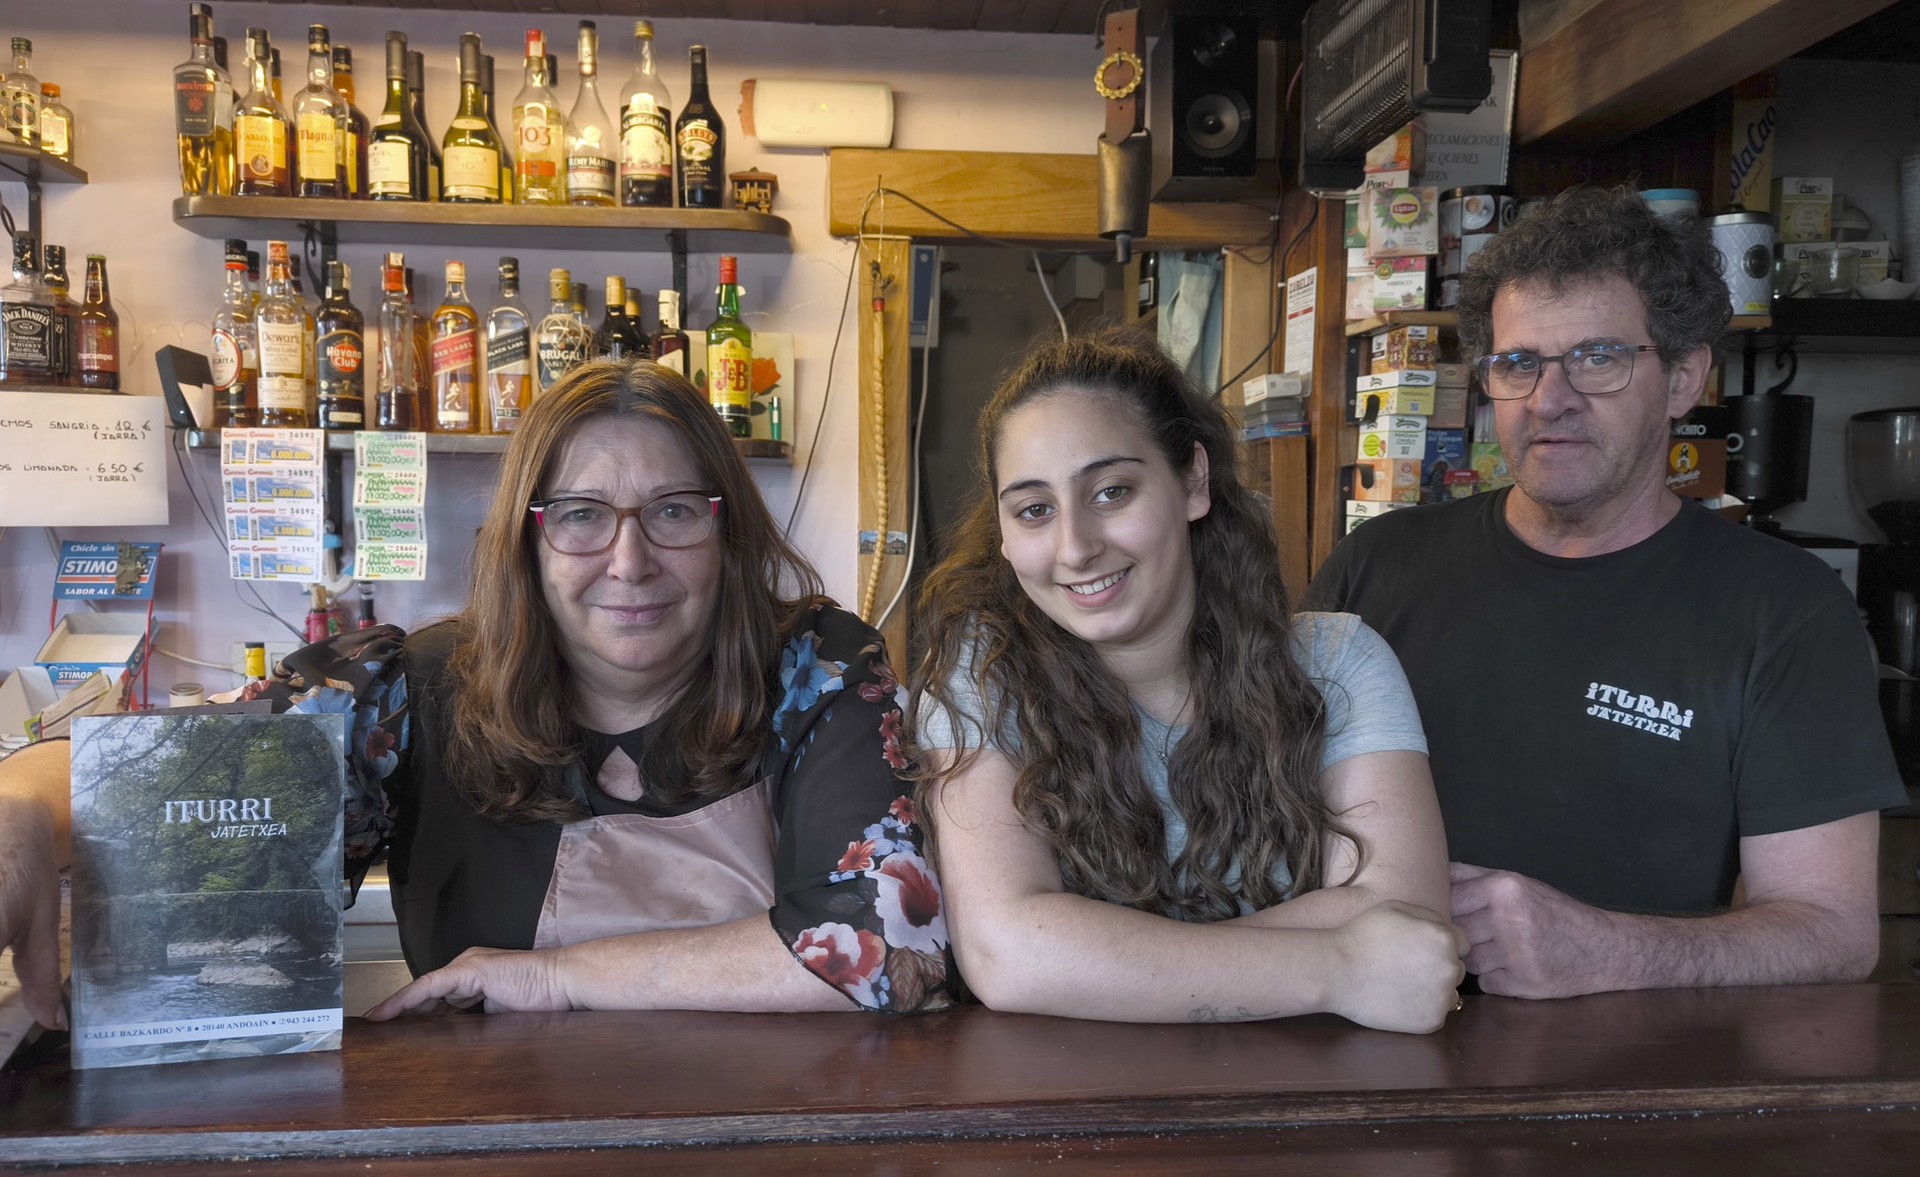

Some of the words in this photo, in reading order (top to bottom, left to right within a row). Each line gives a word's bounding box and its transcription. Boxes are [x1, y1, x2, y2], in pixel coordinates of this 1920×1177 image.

[519, 126, 551, 146] 103
[2, 309, 21, 322] JACK
[21, 307, 51, 327] DANIEL'S
[326, 345, 362, 359] Havana
[449, 341, 473, 352] LABEL
[507, 341, 528, 350] LABEL
[334, 356, 357, 368] Club
[540, 349, 581, 361] BRUGAL
[715, 358, 748, 392] J&B
[71, 544, 98, 552] Chicle
[102, 544, 115, 552] sin
[1586, 704, 1682, 742] JATETXEA
[164, 797, 273, 824] ITURRI
[210, 823, 287, 839] JATETXEA
[84, 1030, 117, 1039] CALLE
[120, 1027, 173, 1038] BAZKARDO
[227, 1020, 269, 1029] ANDOAIN
